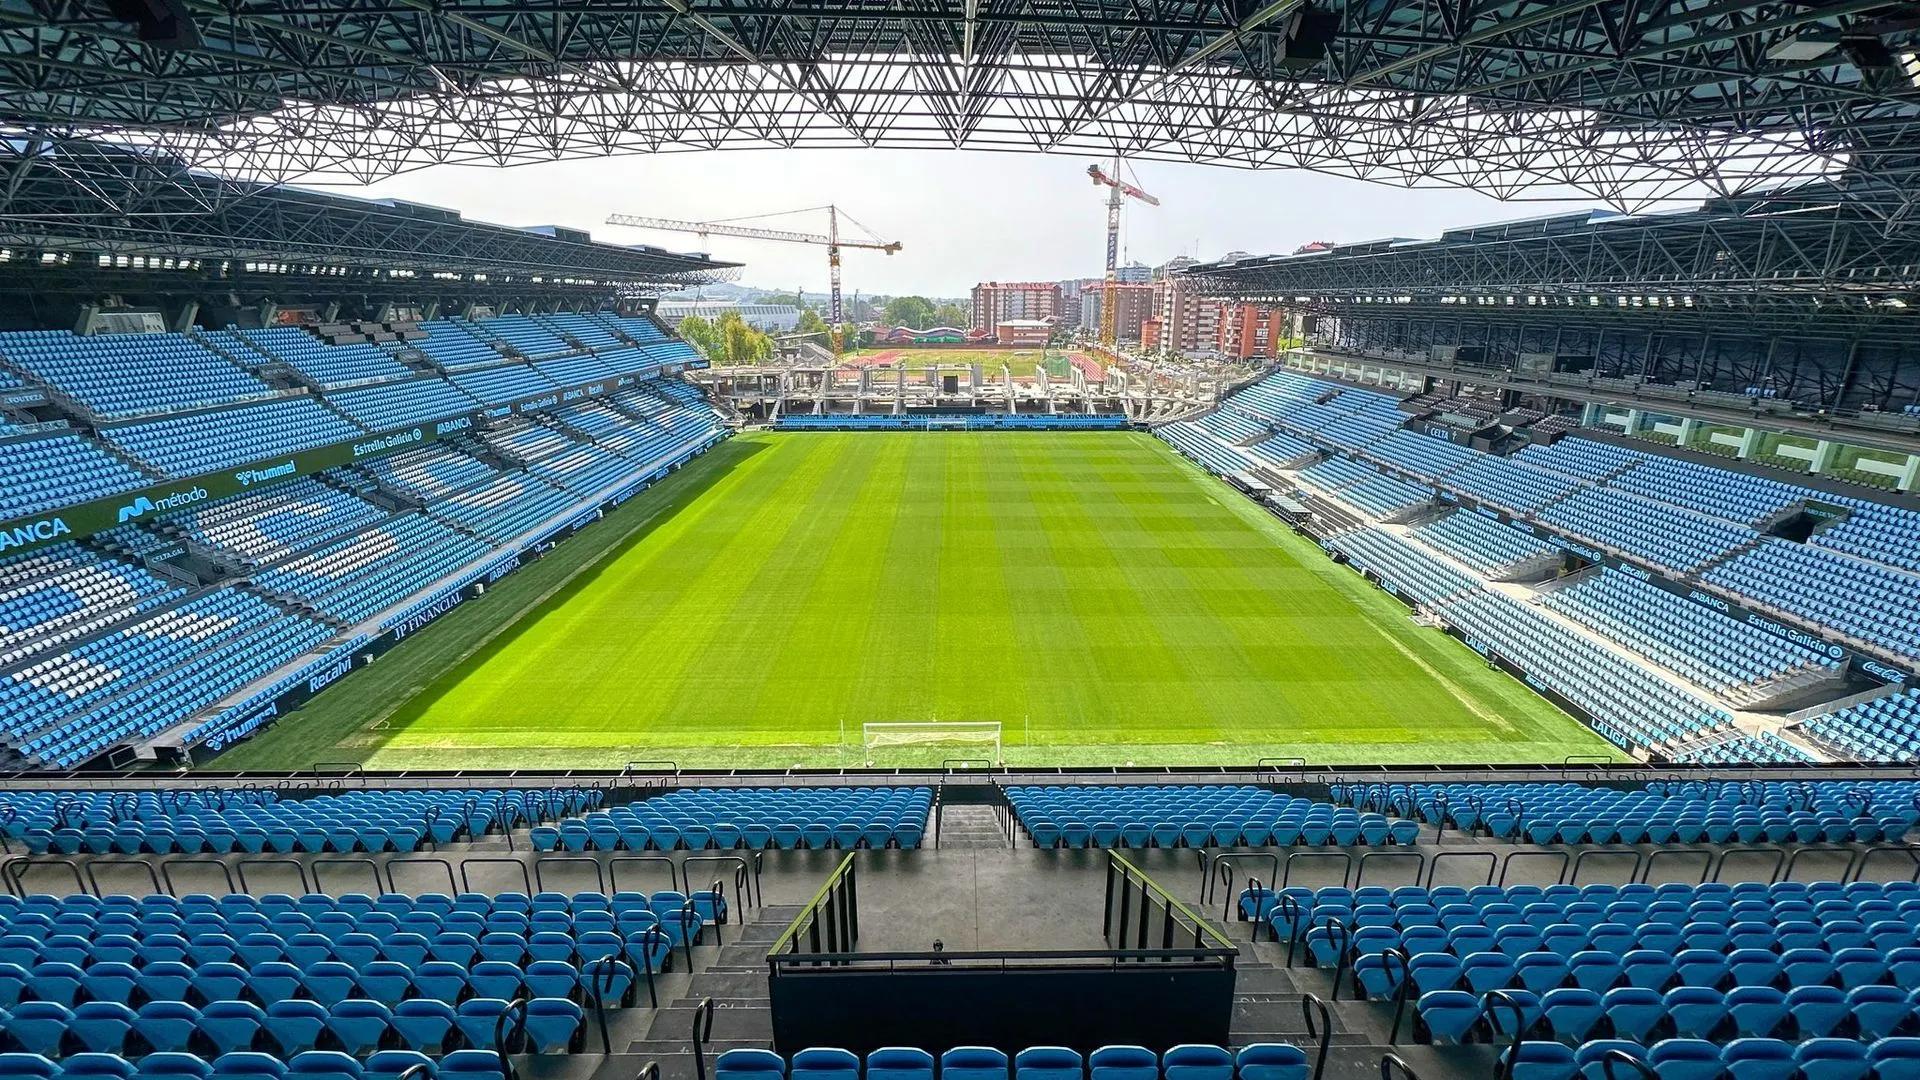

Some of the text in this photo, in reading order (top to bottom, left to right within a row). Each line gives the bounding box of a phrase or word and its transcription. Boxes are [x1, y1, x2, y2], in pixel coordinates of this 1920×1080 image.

[437, 417, 472, 435] ABANCA
[1430, 427, 1449, 440] CELTA
[353, 433, 413, 456] Estrella Galicia
[252, 460, 295, 482] hummel
[156, 486, 208, 512] método
[1511, 519, 1535, 534] ABANCA
[152, 547, 185, 563] CELTA.GAL
[1548, 534, 1592, 559] Estrella Galicia
[489, 557, 521, 583] ABANCA
[1618, 562, 1651, 582] Recalvi
[1689, 590, 1730, 613] ABANCA
[394, 592, 463, 641] JP FINANCIAL
[1464, 633, 1488, 656] LALIGA
[1748, 613, 1827, 653] Estrella Galicia
[309, 656, 352, 693] Recalvi
[1590, 717, 1627, 749] LALIGA
